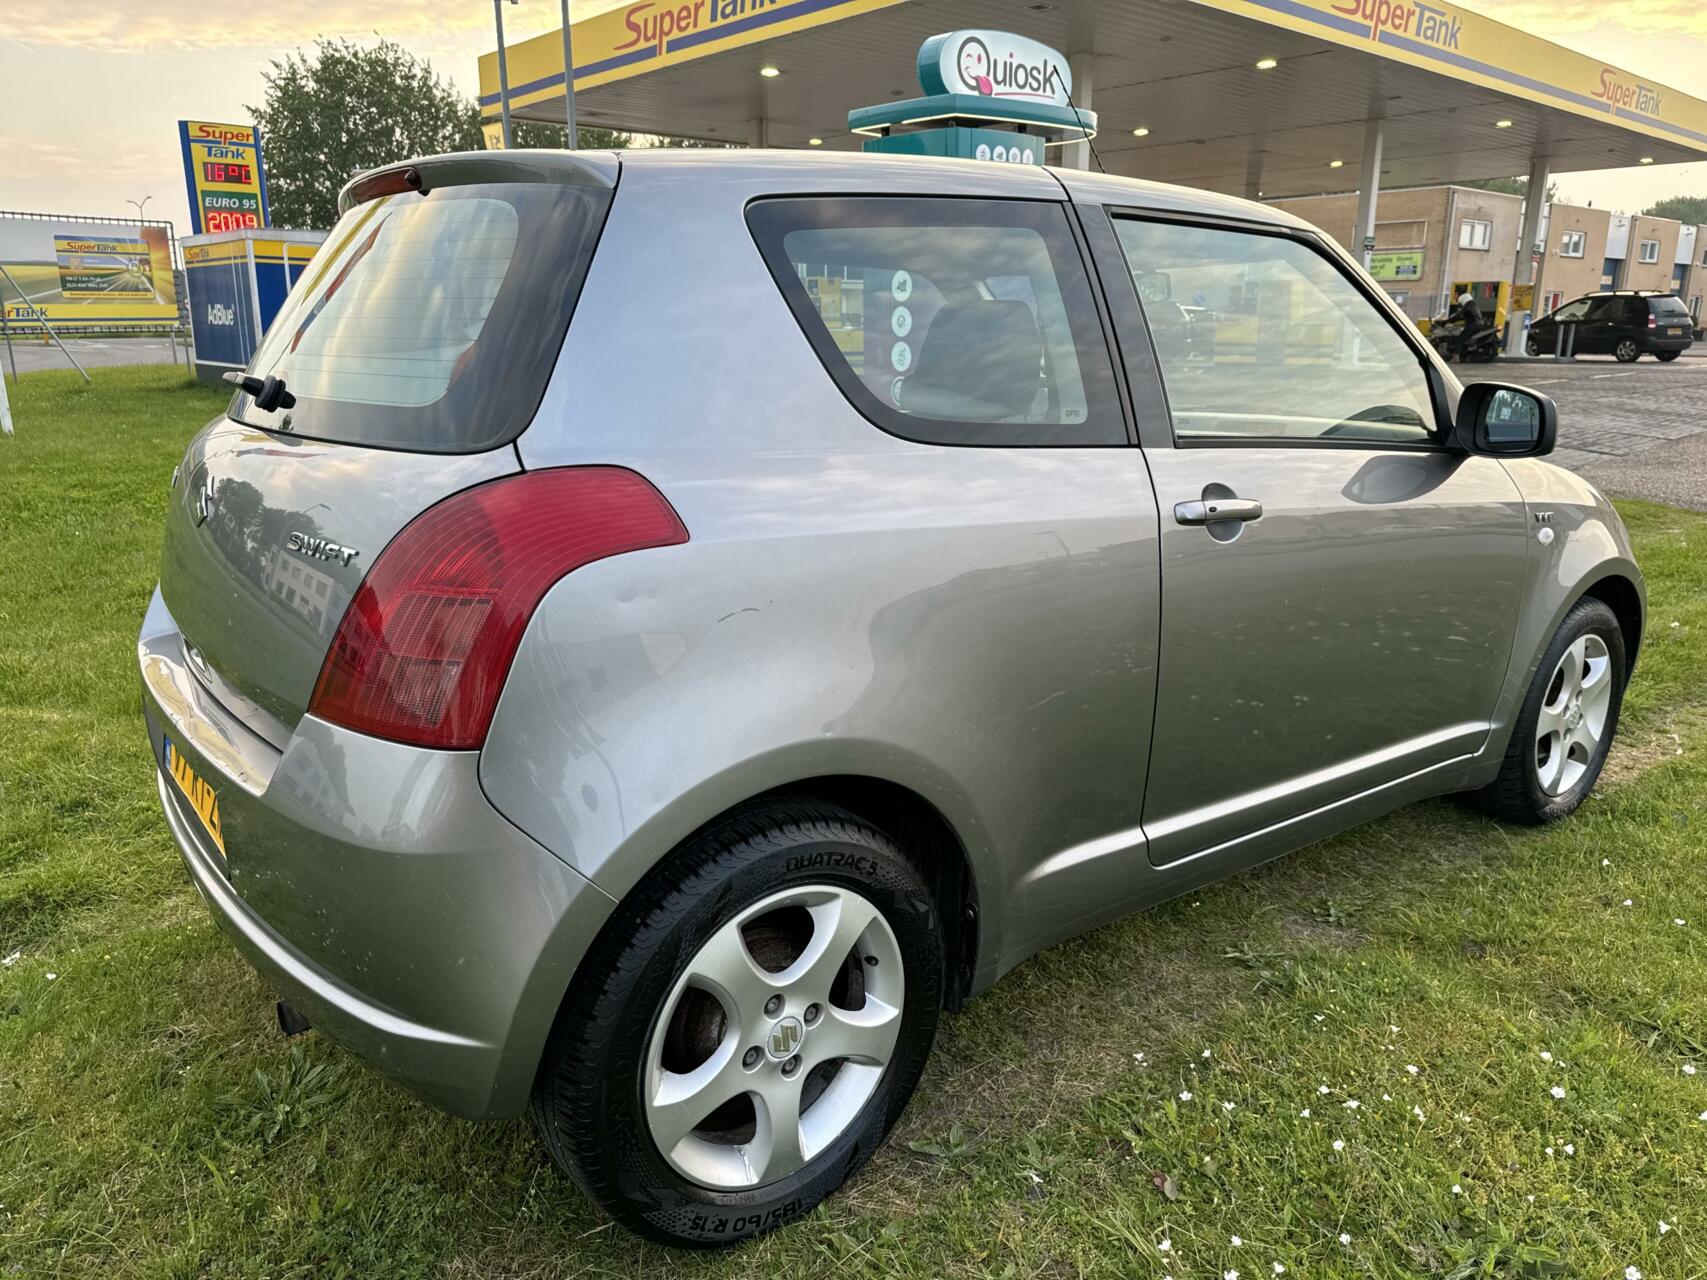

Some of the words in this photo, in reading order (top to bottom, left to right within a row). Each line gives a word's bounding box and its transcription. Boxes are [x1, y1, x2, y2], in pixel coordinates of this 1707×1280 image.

[957, 36, 1056, 97] Quiosk
[1590, 67, 1662, 116] SuperTank
[192, 124, 252, 145] Super
[201, 144, 245, 160] Tank
[205, 197, 239, 207] EURO
[243, 200, 257, 209] 95
[66, 241, 118, 254] SuperTank
[207, 304, 235, 326] AdBlue
[286, 531, 360, 568] SWIFT
[785, 851, 868, 876] QUATRAC
[867, 858, 879, 877] 5
